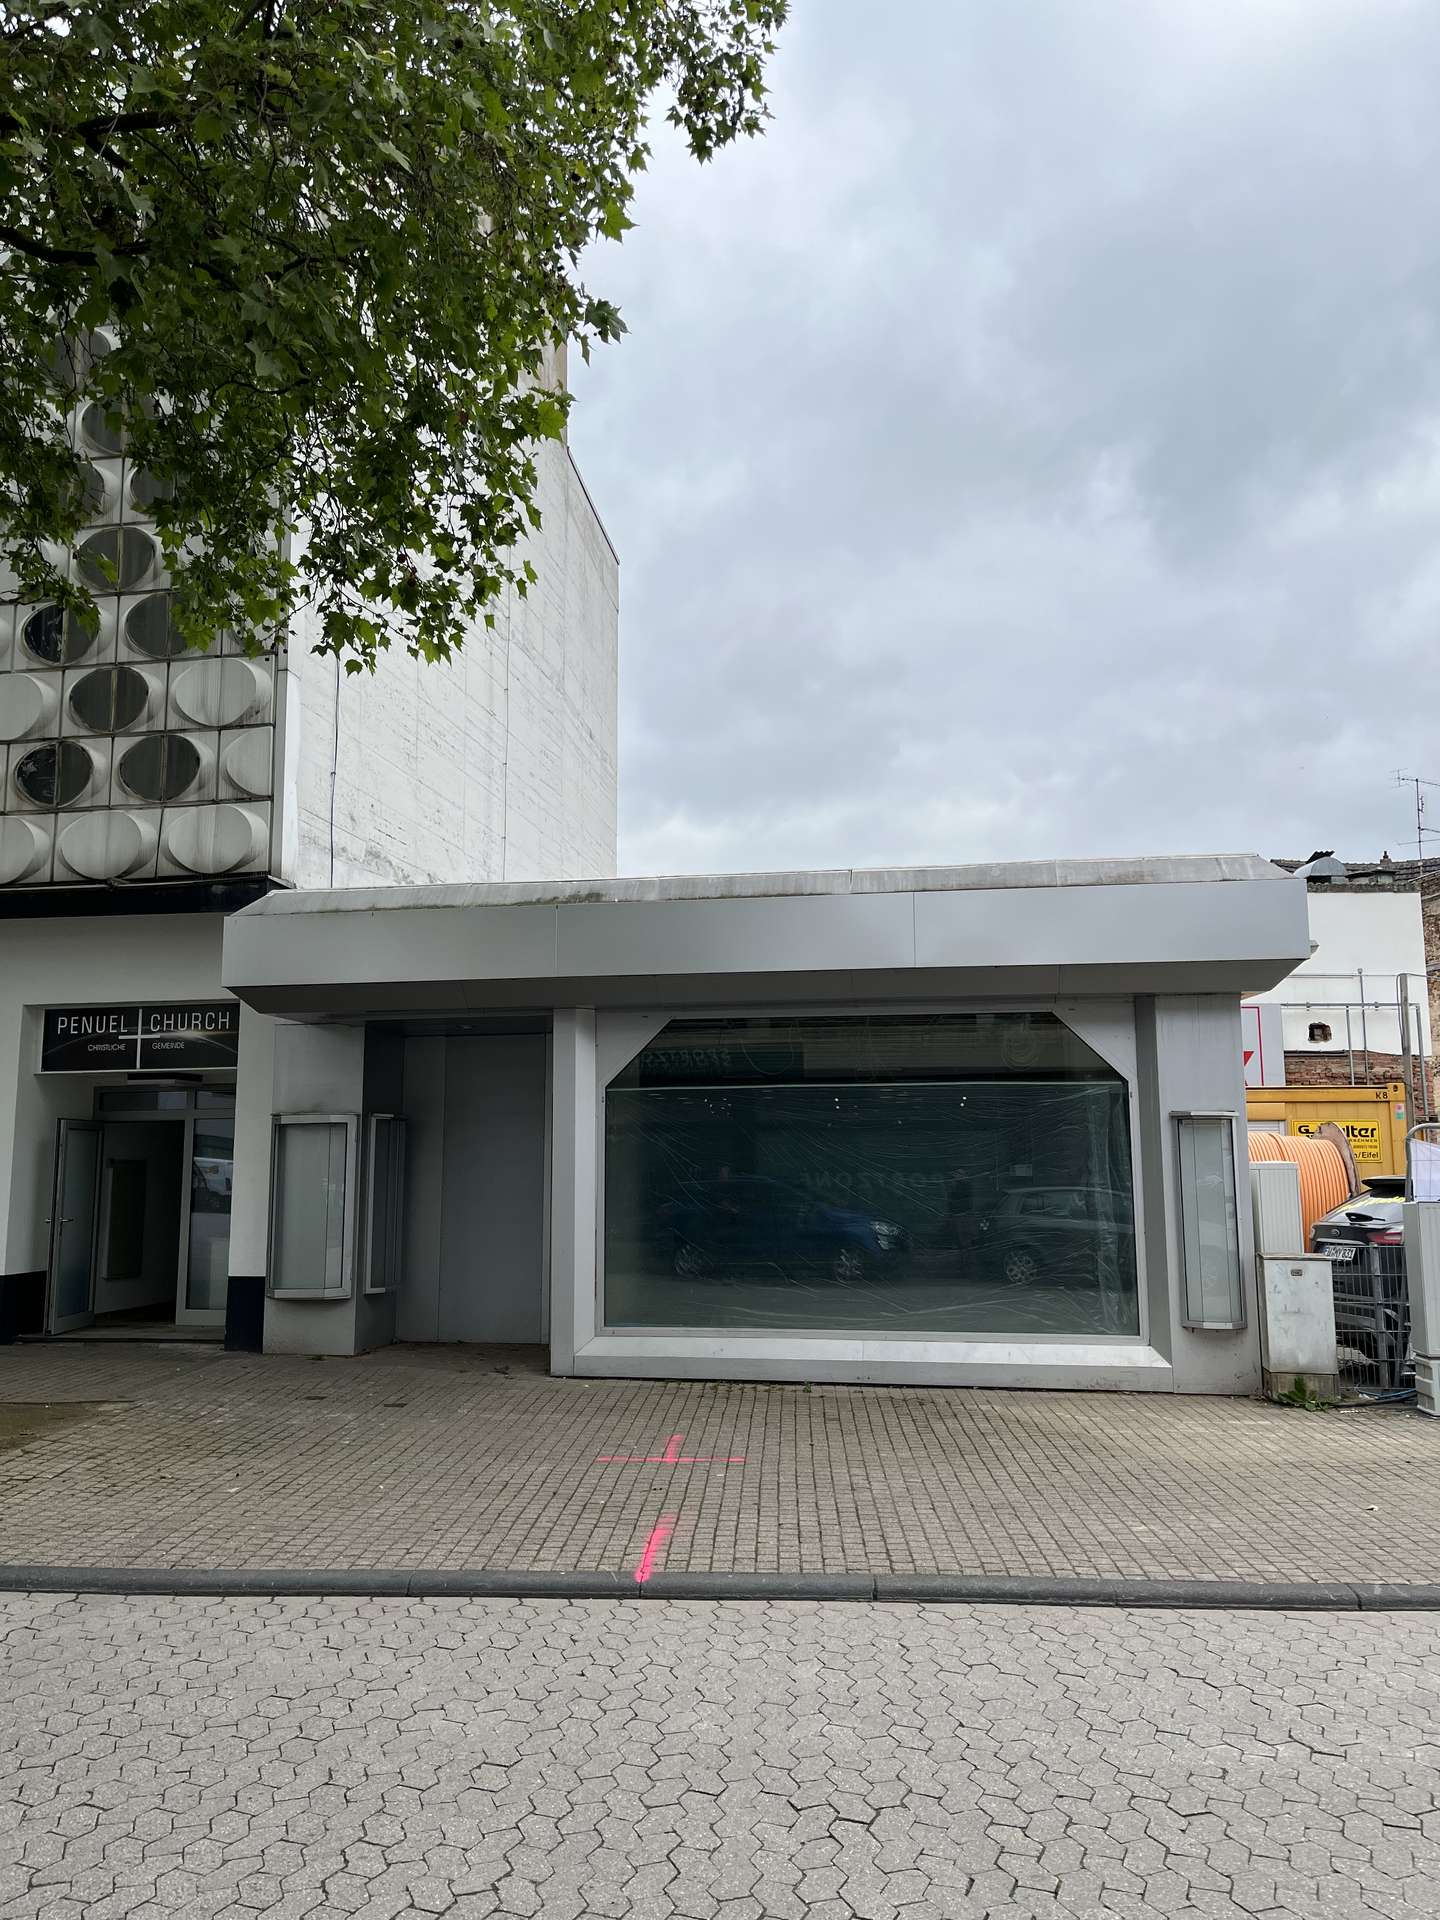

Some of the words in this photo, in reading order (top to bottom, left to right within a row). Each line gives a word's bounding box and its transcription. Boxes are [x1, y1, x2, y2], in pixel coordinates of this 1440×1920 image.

[57, 1015, 128, 1034] PENUEL
[150, 1011, 230, 1032] CHURCH
[87, 1043, 127, 1052] CHRISTLICHE
[151, 1041, 185, 1050] GEMEINDE
